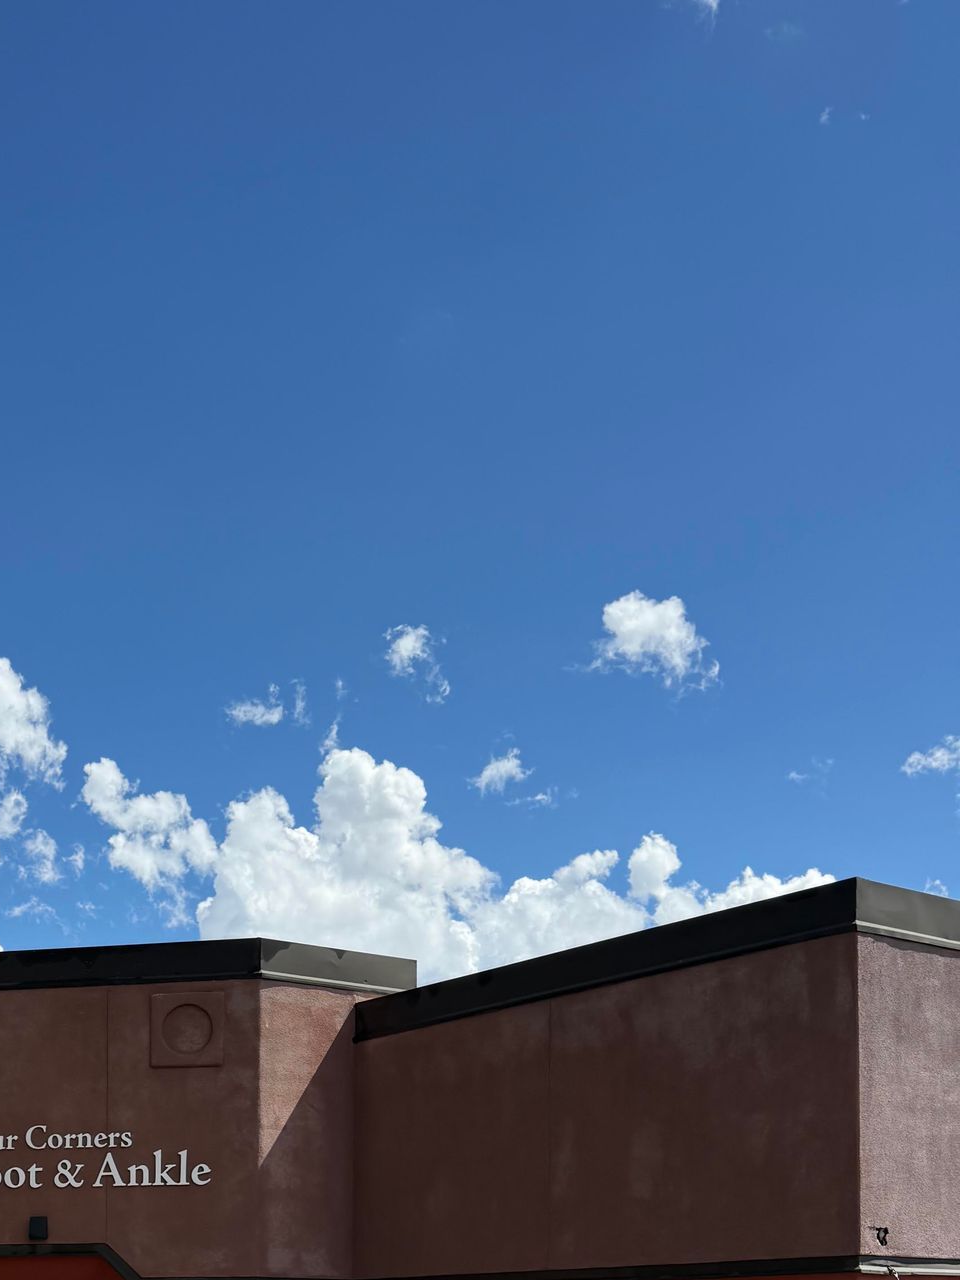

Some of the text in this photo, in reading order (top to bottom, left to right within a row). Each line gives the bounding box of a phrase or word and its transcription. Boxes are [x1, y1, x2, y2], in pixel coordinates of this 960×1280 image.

[25, 1125, 133, 1150] Corners
[53, 1159, 85, 1188] &
[92, 1149, 212, 1188] Ankle
